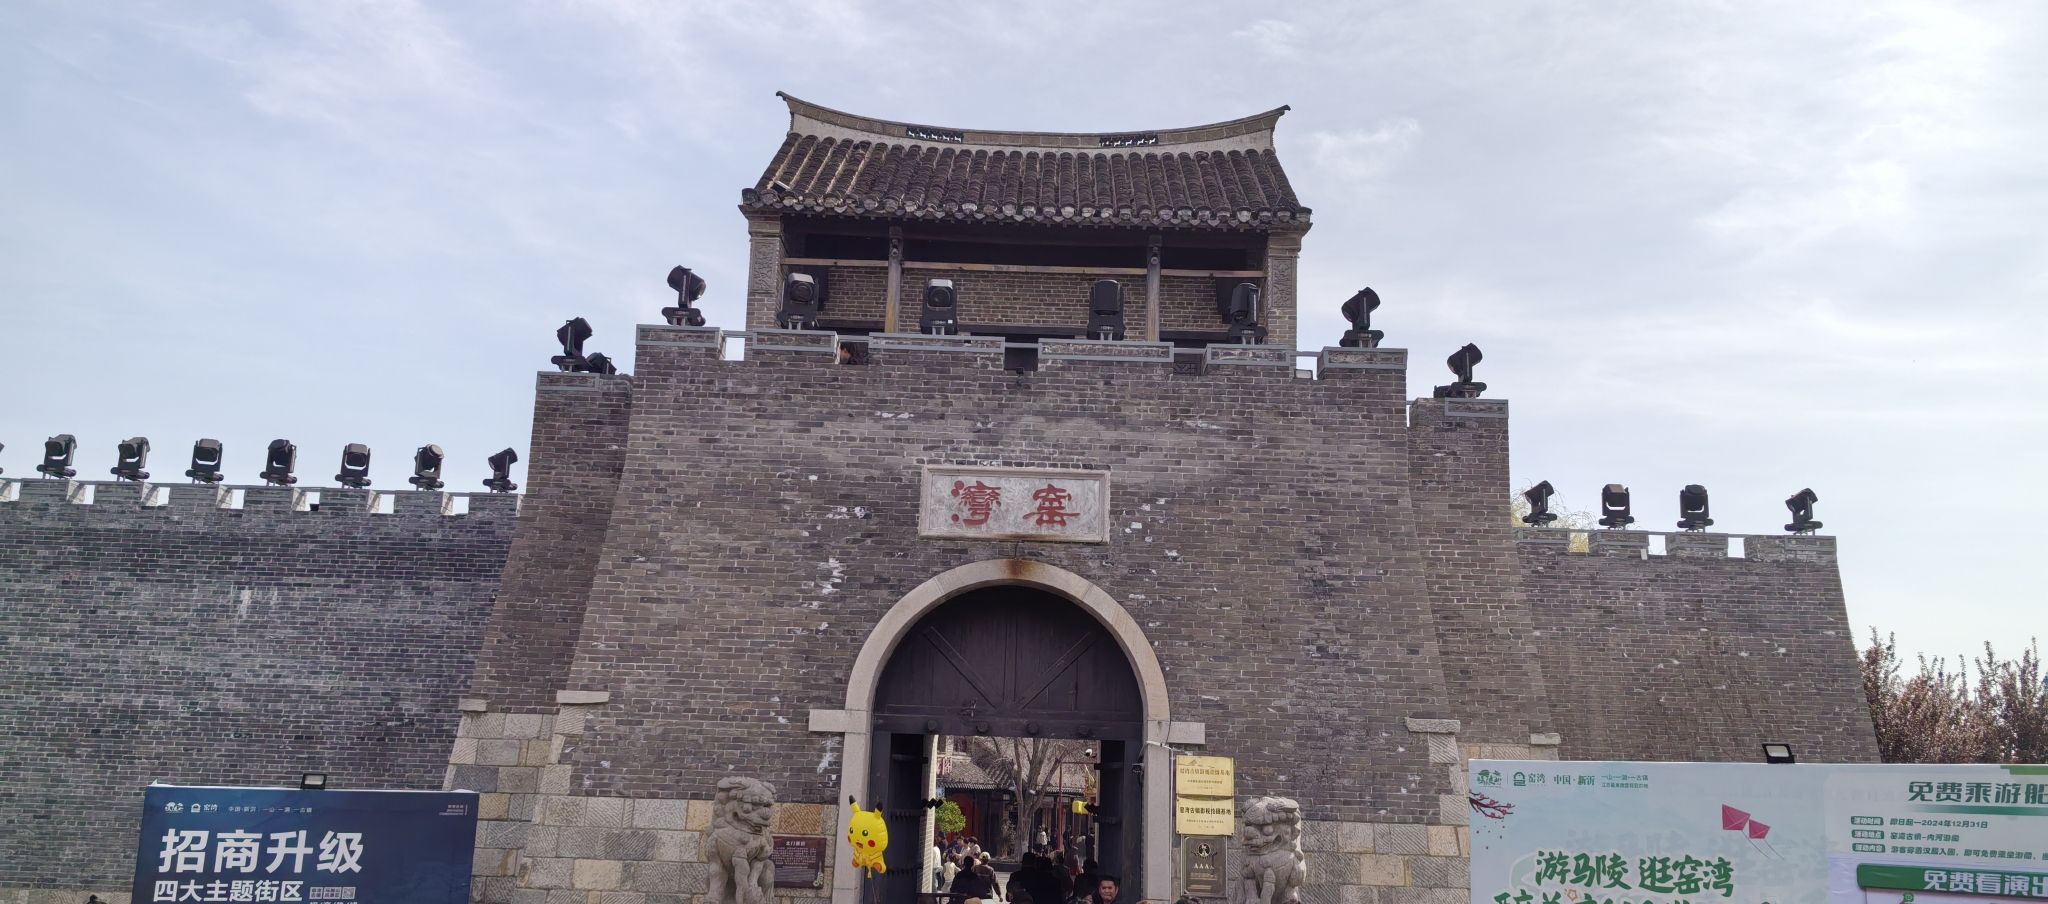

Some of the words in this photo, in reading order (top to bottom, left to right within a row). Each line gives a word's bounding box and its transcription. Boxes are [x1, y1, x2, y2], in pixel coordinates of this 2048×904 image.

[158, 828, 364, 874] 招商升级
[1535, 851, 1632, 890] 游马陵
[1638, 854, 1735, 897] 逛窑湾
[153, 880, 304, 902] 四大主题街区
